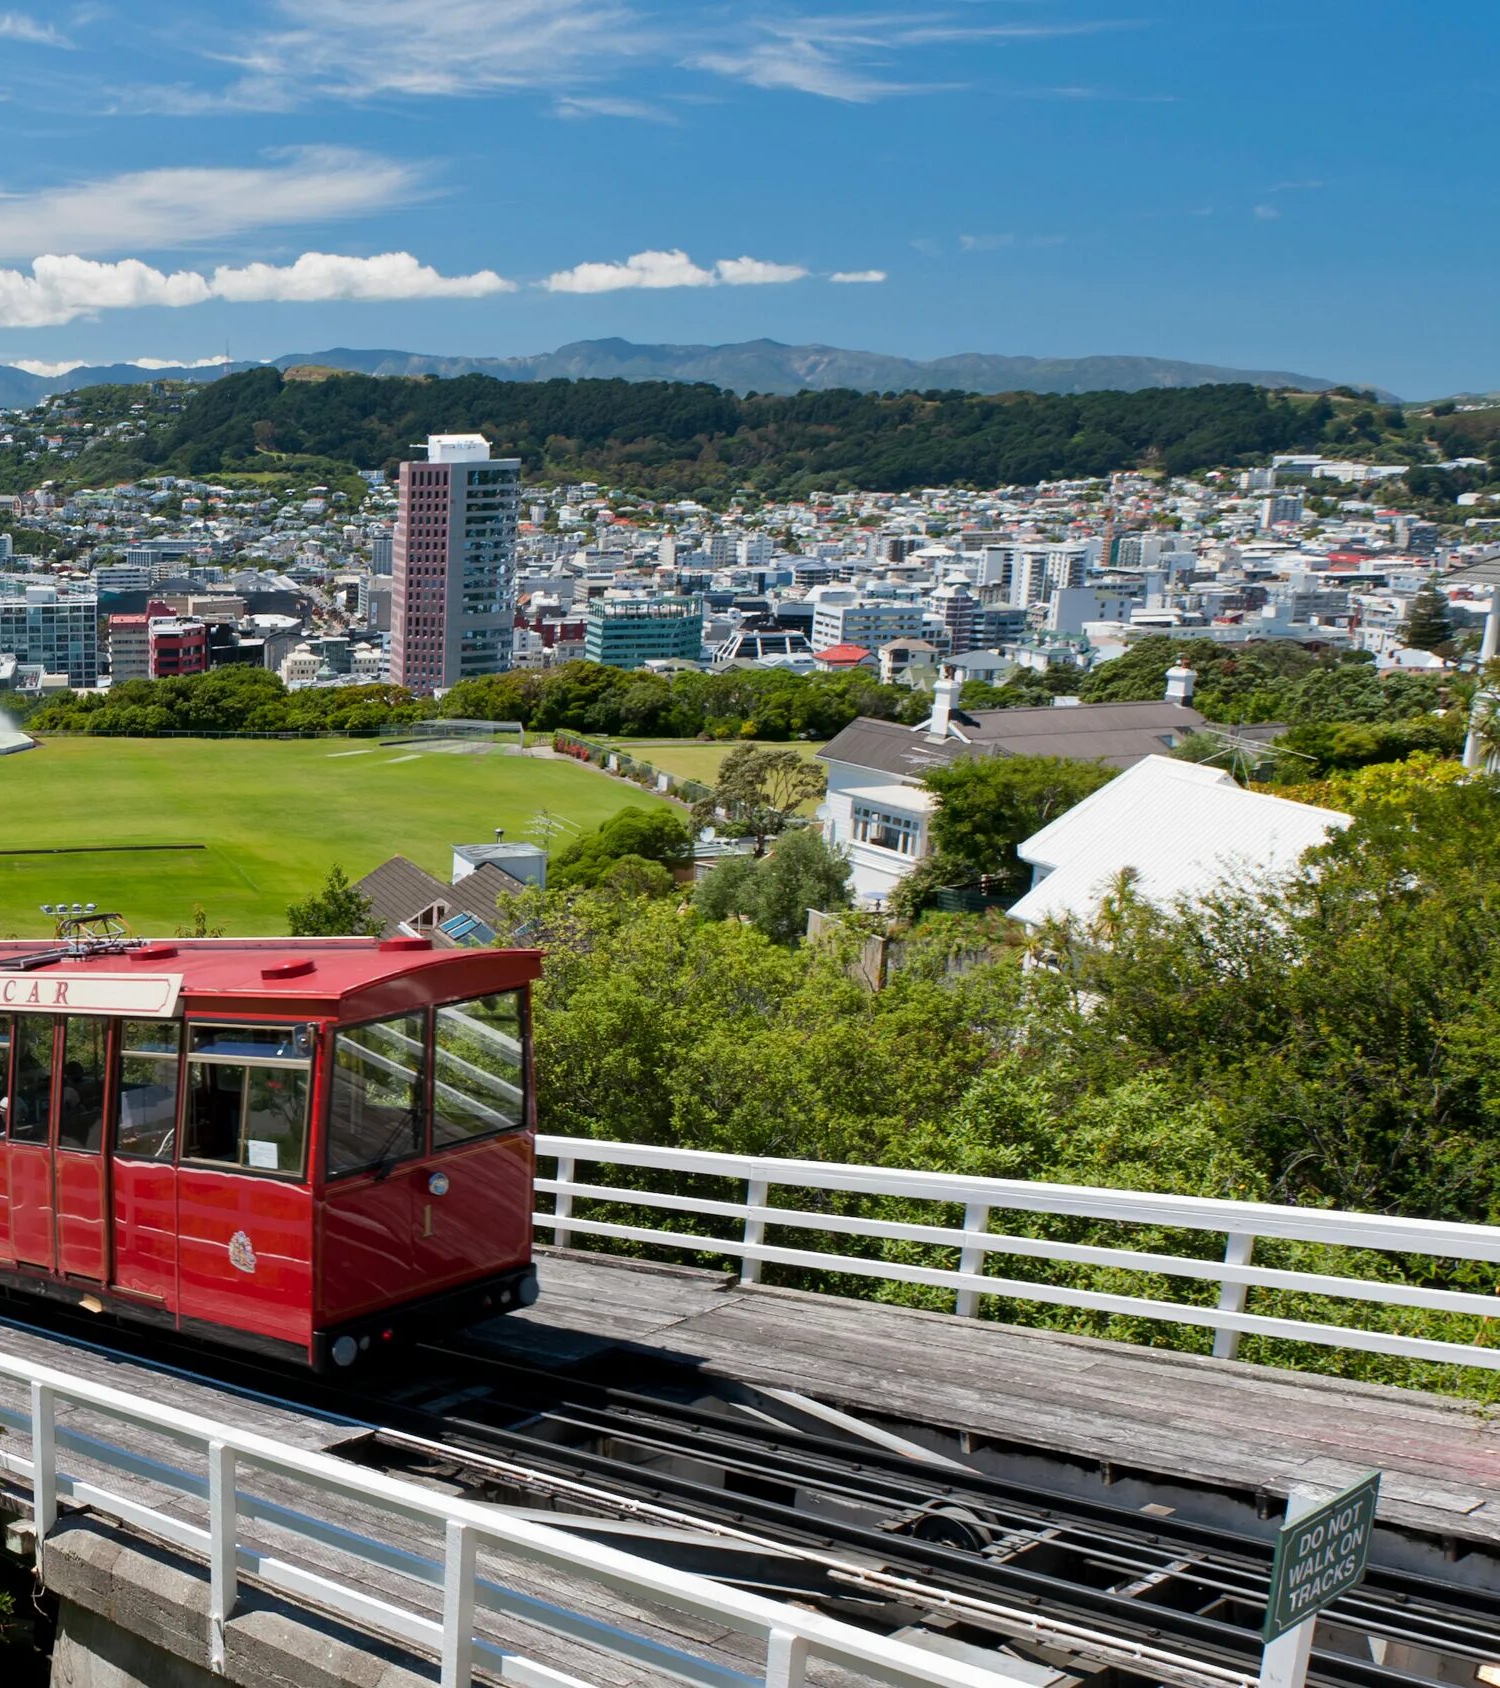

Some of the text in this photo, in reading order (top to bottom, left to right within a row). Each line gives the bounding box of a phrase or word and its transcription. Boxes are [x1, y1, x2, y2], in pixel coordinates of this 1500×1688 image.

[3, 980, 69, 1005] CAR
[421, 1204, 435, 1238] 1
[1289, 1524, 1364, 1588] WALK ON
[1299, 1501, 1363, 1557] DO NOT
[1289, 1555, 1355, 1612] TRACKS
